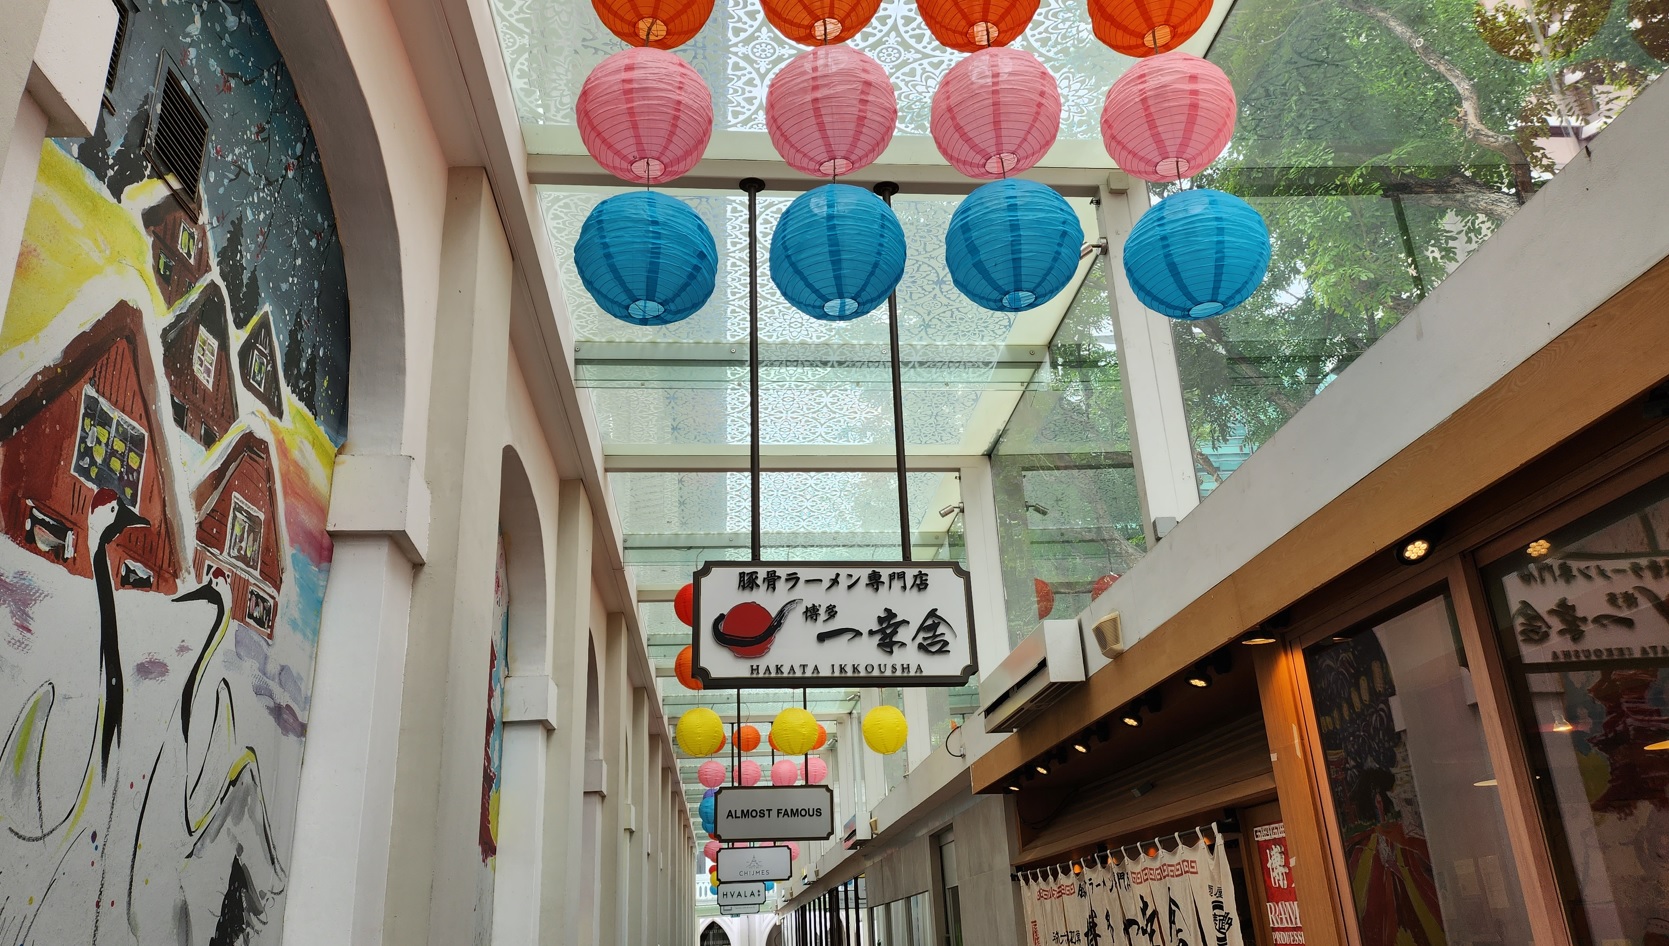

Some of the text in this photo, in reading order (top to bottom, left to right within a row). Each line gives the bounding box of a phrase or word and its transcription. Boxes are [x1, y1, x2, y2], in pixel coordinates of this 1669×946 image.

[737, 570, 930, 592] 豚骨ラーメン専門店
[802, 604, 838, 622] 博多
[750, 663, 924, 675] HAKATA IKKOUSHA
[726, 808, 823, 819] ALMOST FAMOUS
[722, 891, 756, 899] HVALA
